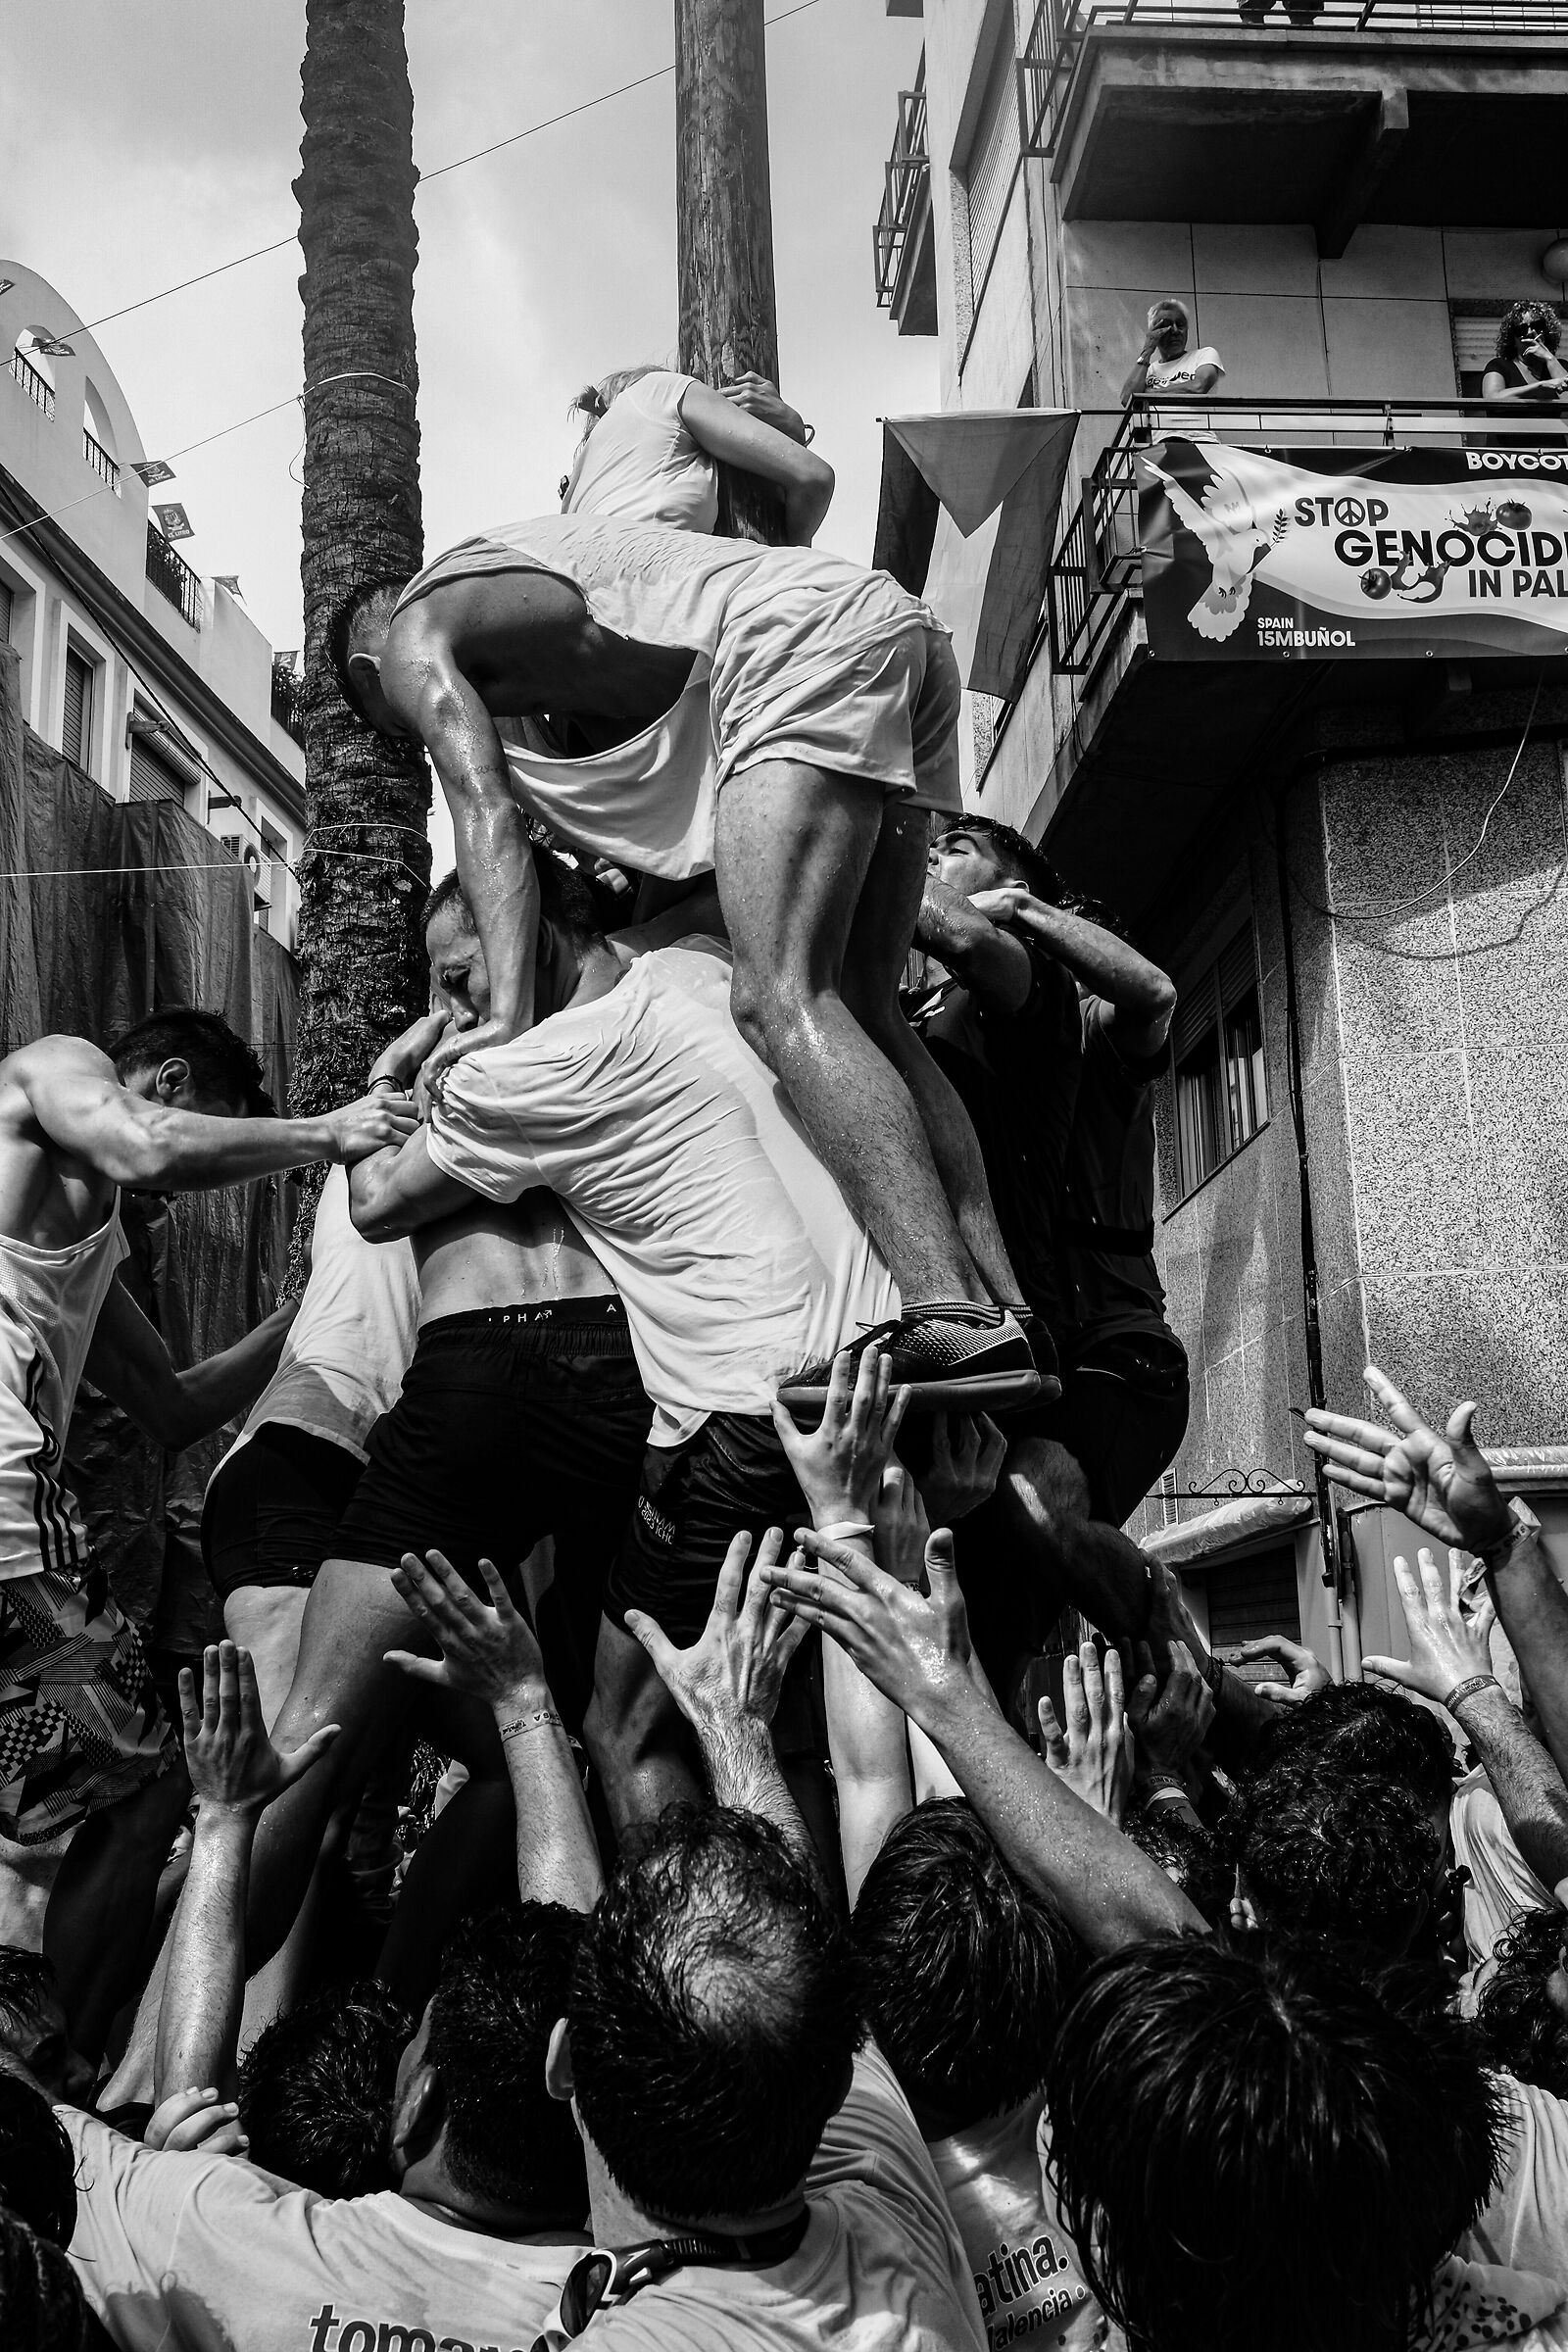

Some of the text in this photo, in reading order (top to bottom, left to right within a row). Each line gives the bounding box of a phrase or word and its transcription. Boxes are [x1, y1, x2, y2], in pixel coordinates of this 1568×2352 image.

[1294, 496, 1390, 527] STOP
[1334, 529, 1568, 567] GENOCID
[1468, 569, 1568, 598] IN PAL
[1257, 617, 1294, 629] SPAIN
